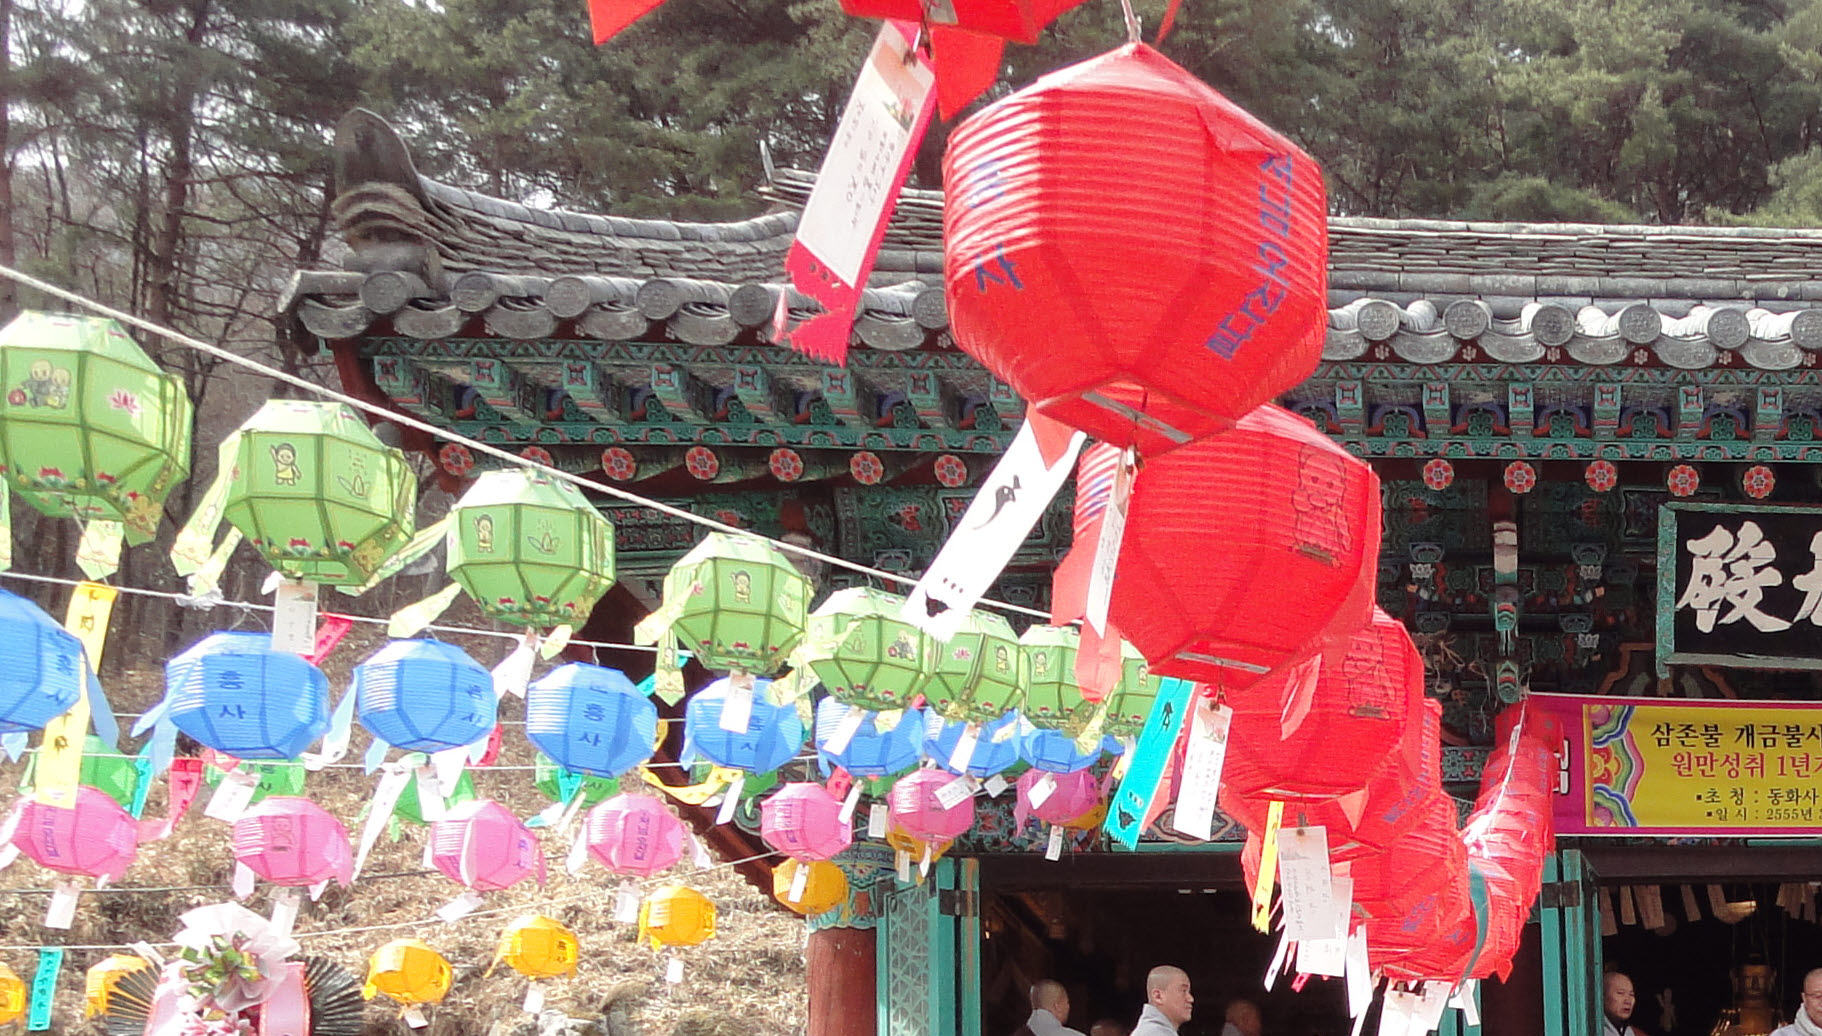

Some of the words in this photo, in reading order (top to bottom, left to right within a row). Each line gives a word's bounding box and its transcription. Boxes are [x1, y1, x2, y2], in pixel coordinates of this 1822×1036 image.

[1651, 721, 1724, 750] 삼존불
[1671, 751, 1767, 779] 원만성취
[1766, 787, 1820, 806] 동화사
[1766, 807, 1813, 821] 2555년
